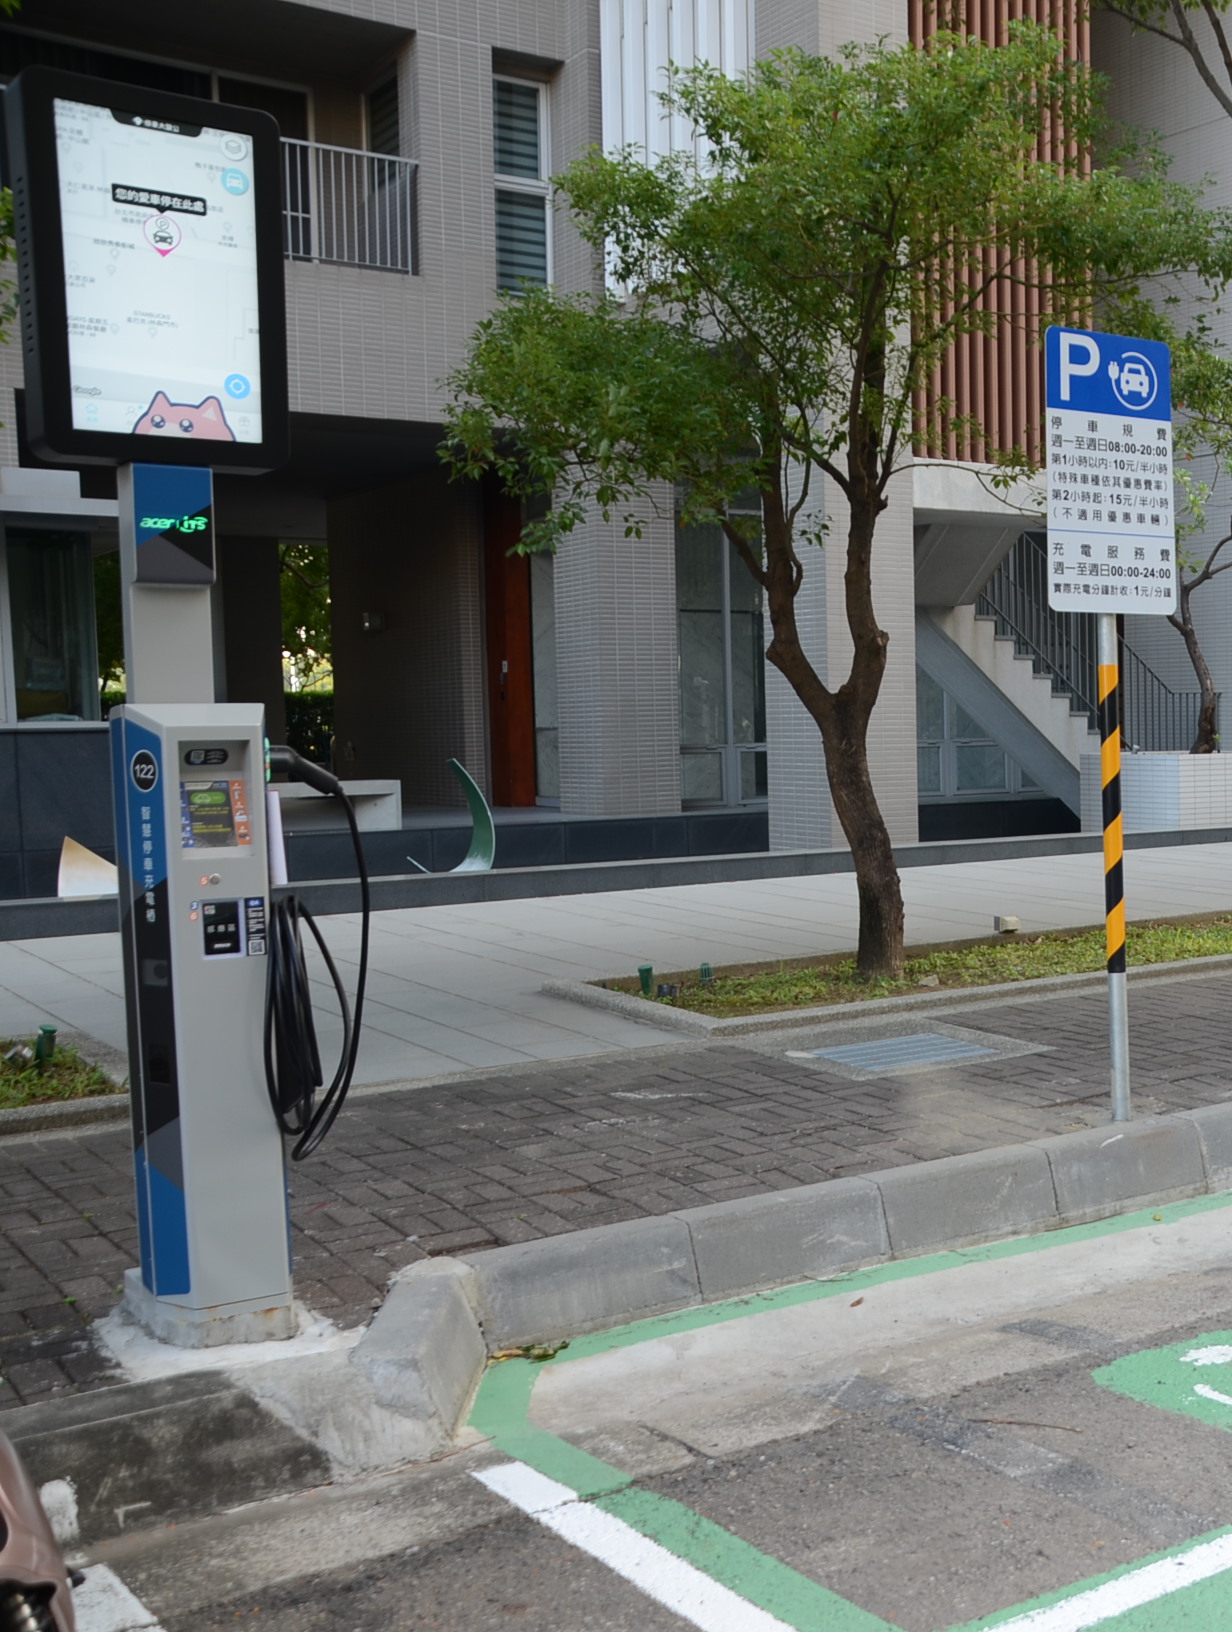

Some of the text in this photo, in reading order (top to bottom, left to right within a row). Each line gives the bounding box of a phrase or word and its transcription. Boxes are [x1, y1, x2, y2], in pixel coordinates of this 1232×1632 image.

[114, 187, 205, 213] 您的愛車停在此處
[1059, 332, 1100, 401] P
[140, 517, 176, 529] acer
[134, 764, 154, 779] 122
